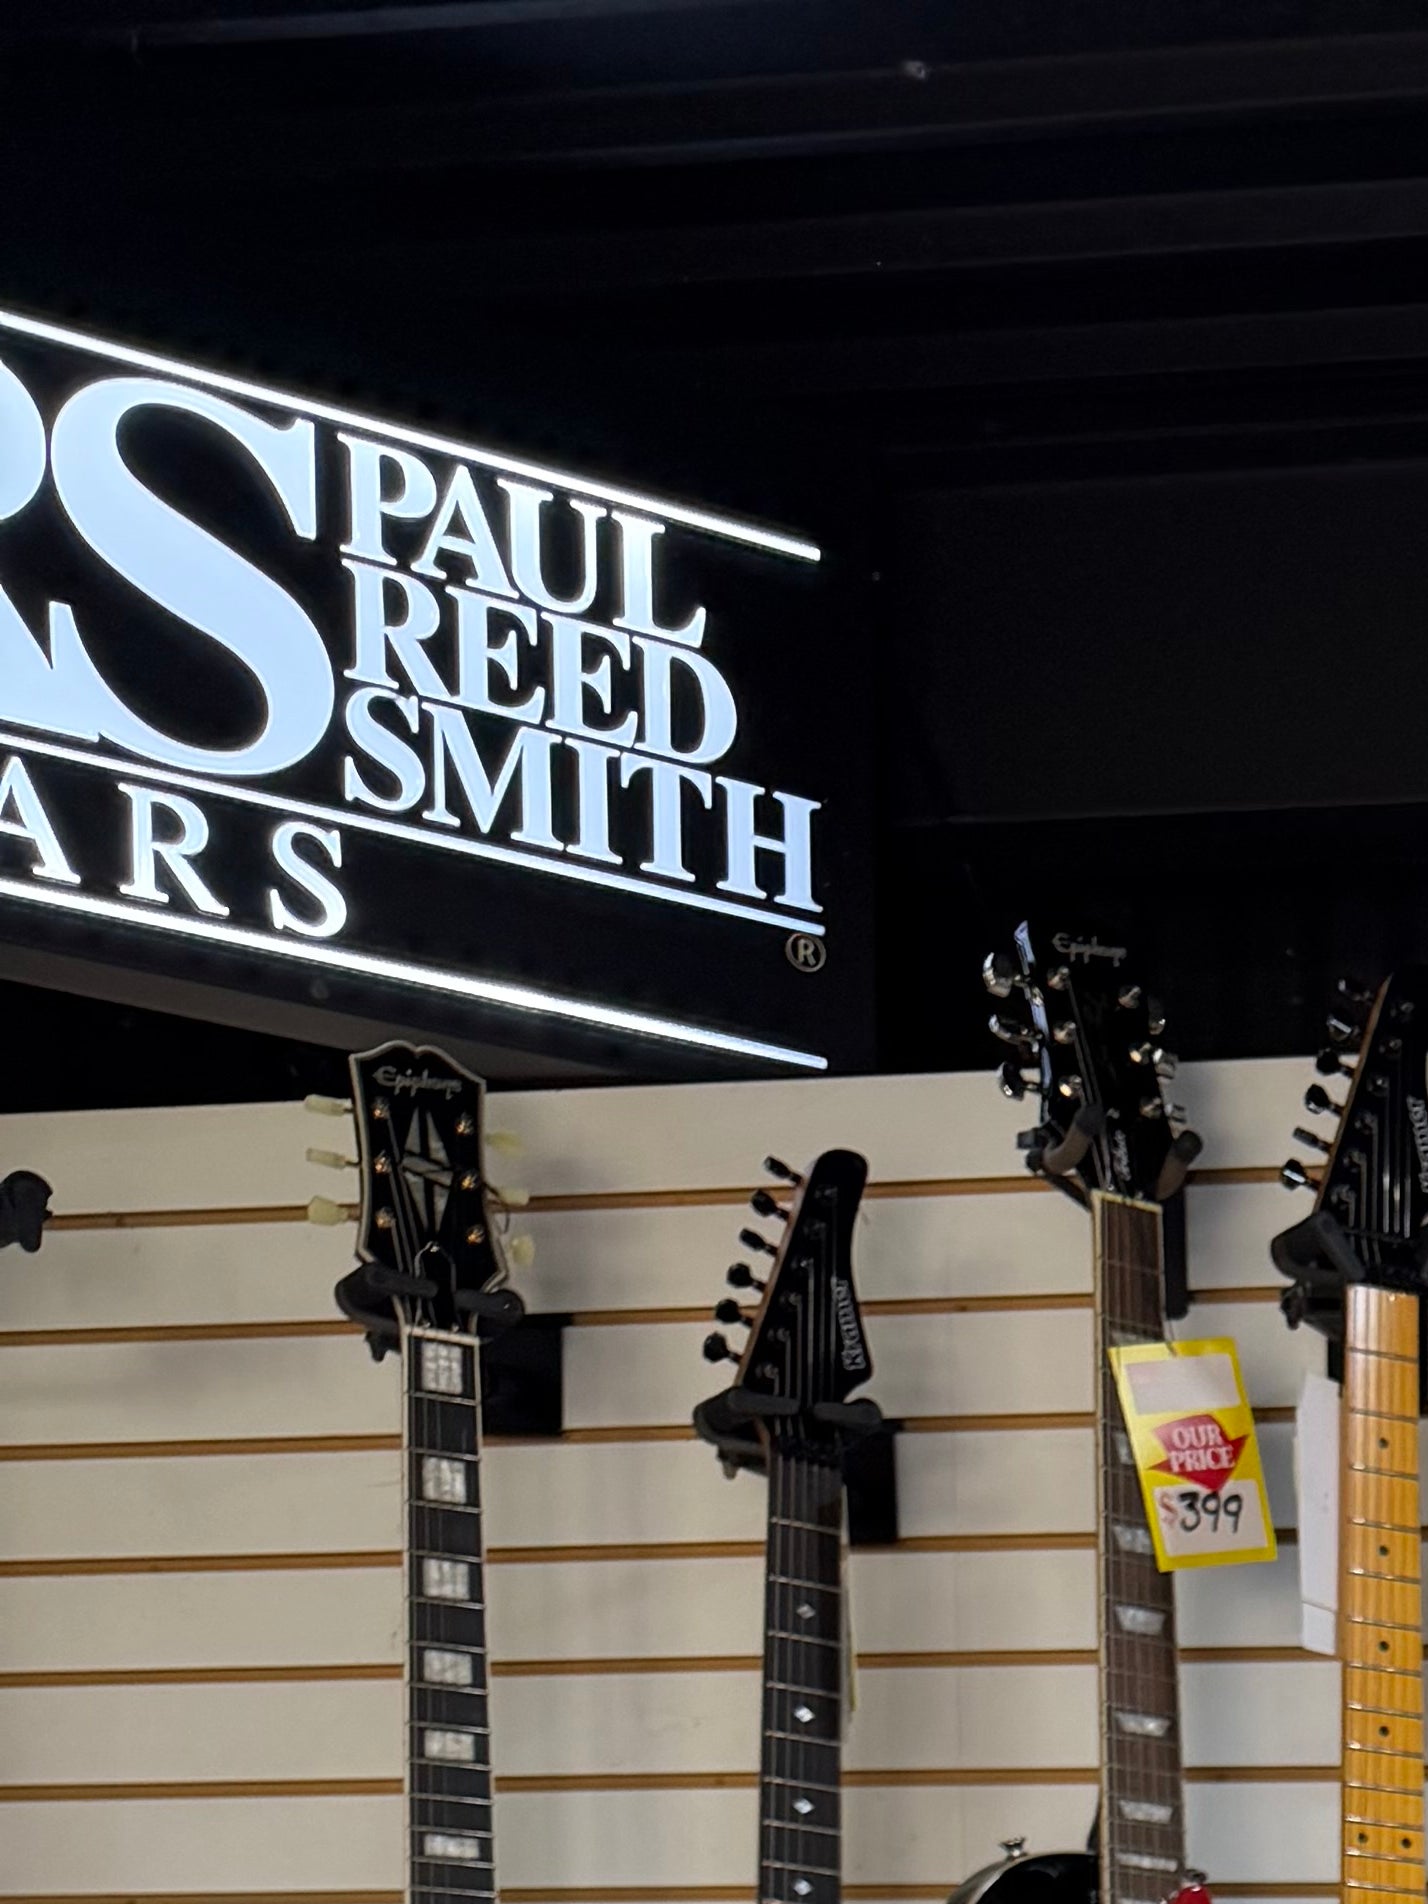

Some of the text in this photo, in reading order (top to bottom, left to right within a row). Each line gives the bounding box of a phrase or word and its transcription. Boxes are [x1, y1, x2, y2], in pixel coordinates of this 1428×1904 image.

[338, 432, 706, 647] PAUL
[341, 557, 738, 766] REED
[343, 690, 824, 913] SMITH
[1167, 1446, 1236, 1474] PRICE
[1171, 1424, 1223, 1450] OUR
[1158, 1490, 1243, 1535] $399
